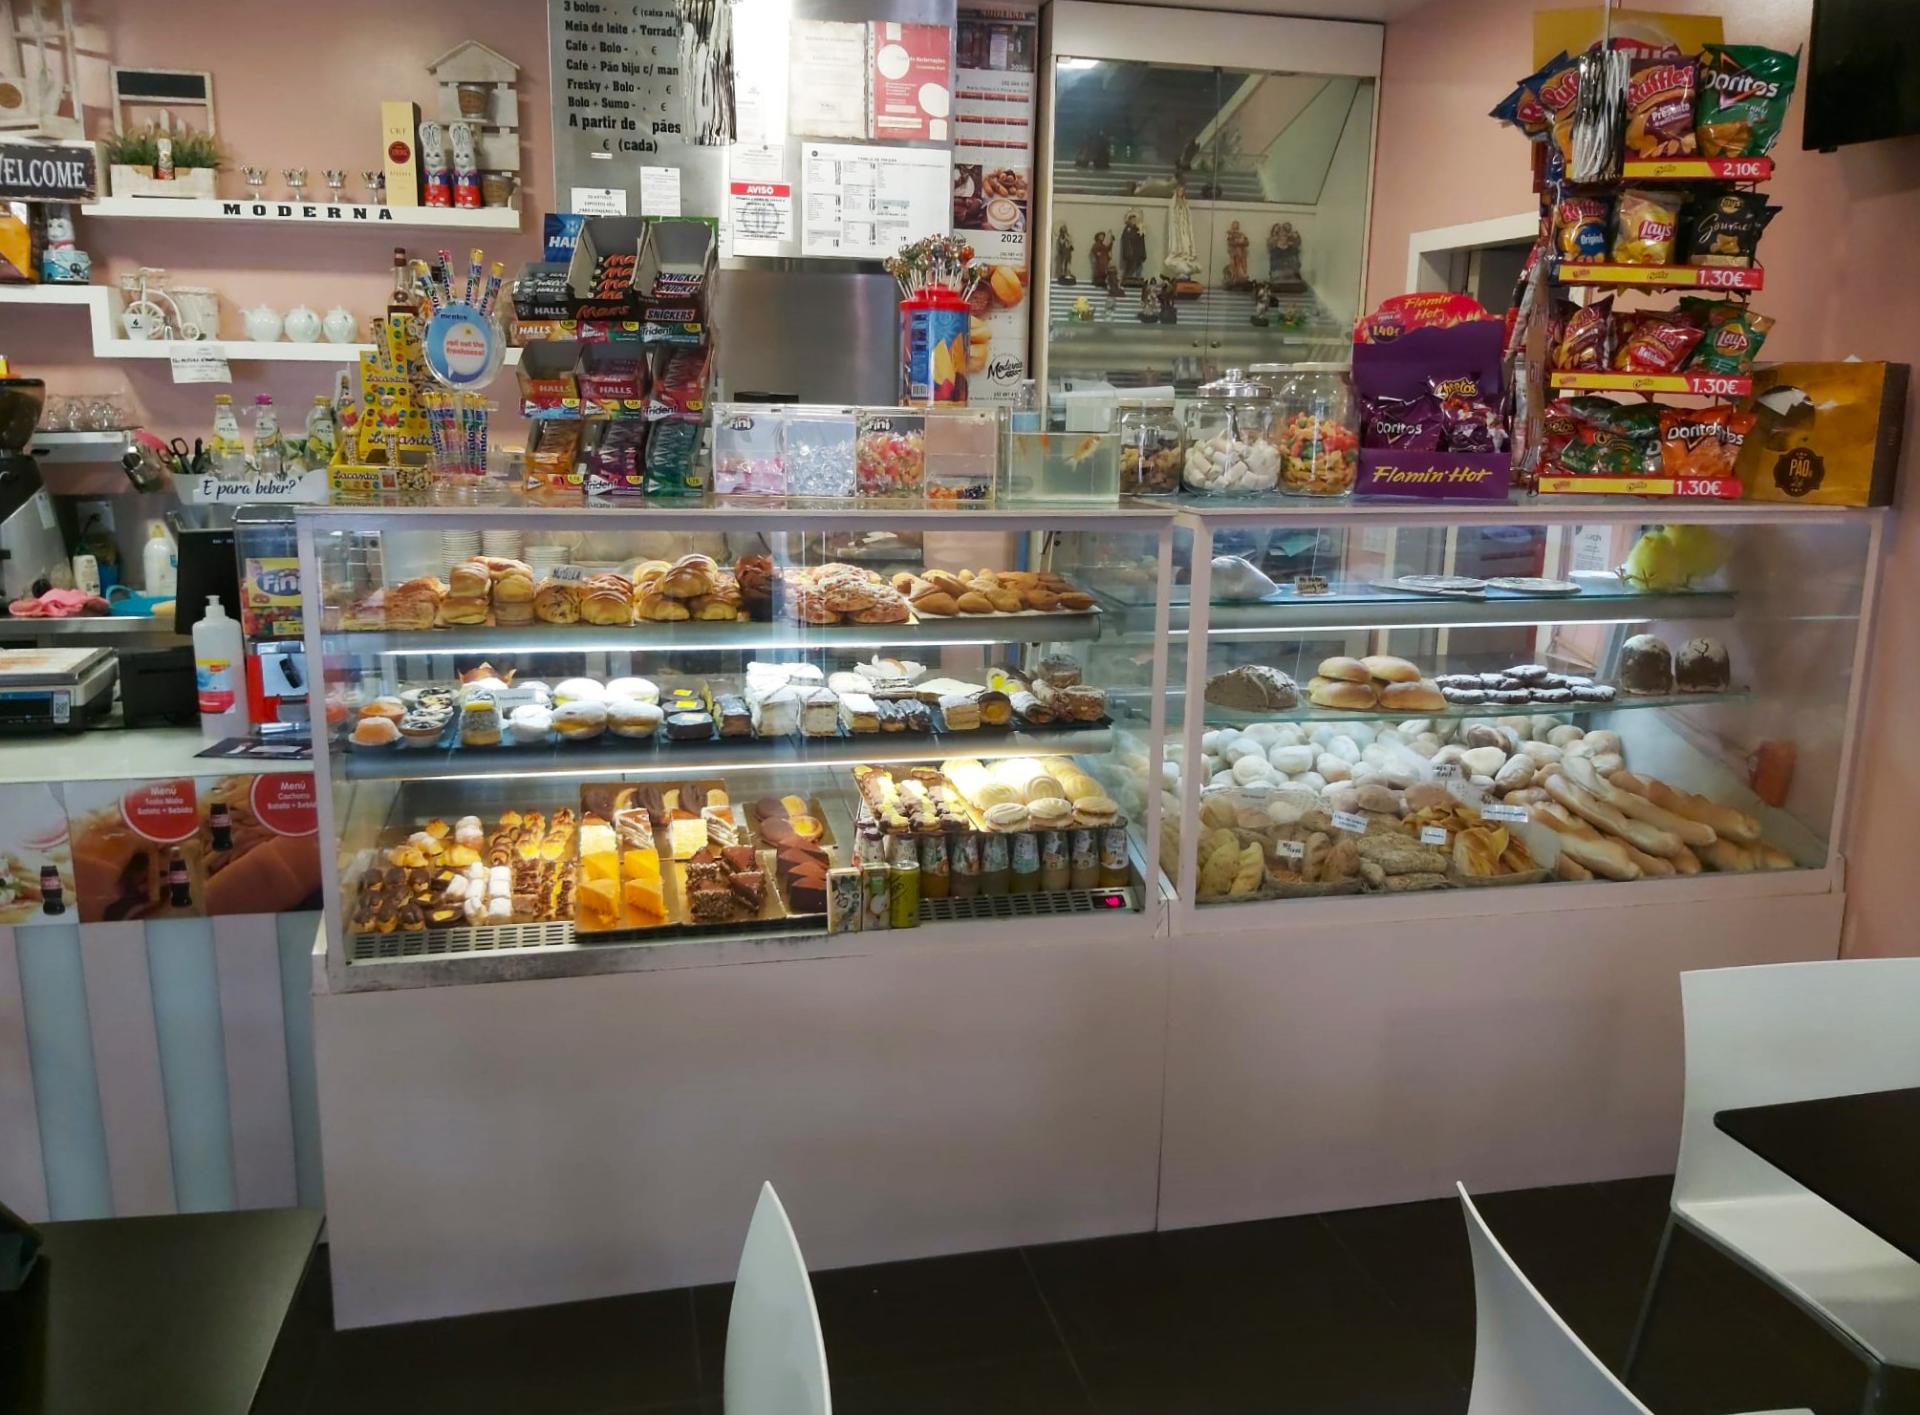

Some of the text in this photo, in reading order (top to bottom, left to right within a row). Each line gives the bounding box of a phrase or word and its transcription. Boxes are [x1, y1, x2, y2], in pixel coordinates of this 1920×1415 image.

[573, 1, 600, 13] bolos
[565, 20, 589, 33] Meia
[591, 21, 604, 34] de
[606, 22, 628, 35] leite
[565, 40, 588, 52] Café
[599, 41, 621, 53] Bolo
[566, 59, 588, 71] Café
[600, 61, 619, 73] Pão
[567, 78, 601, 94] Fresky
[613, 80, 634, 92] Bolo
[1629, 65, 1695, 108] Ruffles
[1705, 70, 1780, 98] Doritos
[568, 96, 590, 108] Bolo
[601, 97, 629, 110] Sumo
[569, 113, 681, 135] A partir de pães
[618, 139, 658, 154] (cada)
[746, 186, 774, 196] AVISO
[223, 203, 394, 220] MODERNA
[549, 236, 577, 249] HAL
[1001, 233, 1024, 244] 2022
[1699, 270, 1746, 287] 1.30€
[534, 306, 568, 315] HALLS
[647, 309, 693, 321] SNICKERS
[1414, 309, 1441, 322] Hot
[519, 326, 551, 336] HALLS
[641, 326, 672, 337] Trident
[539, 384, 572, 394] HALLS
[599, 386, 633, 395] HALLS
[1436, 379, 1478, 396] Cheetos
[1693, 378, 1739, 395] 1.30€
[1376, 421, 1423, 436] Doritos
[1667, 421, 1721, 440] Doritos
[216, 483, 251, 500] para
[255, 479, 297, 495] beber?
[1676, 480, 1722, 496] 1.30€
[280, 780, 306, 791] Menú
